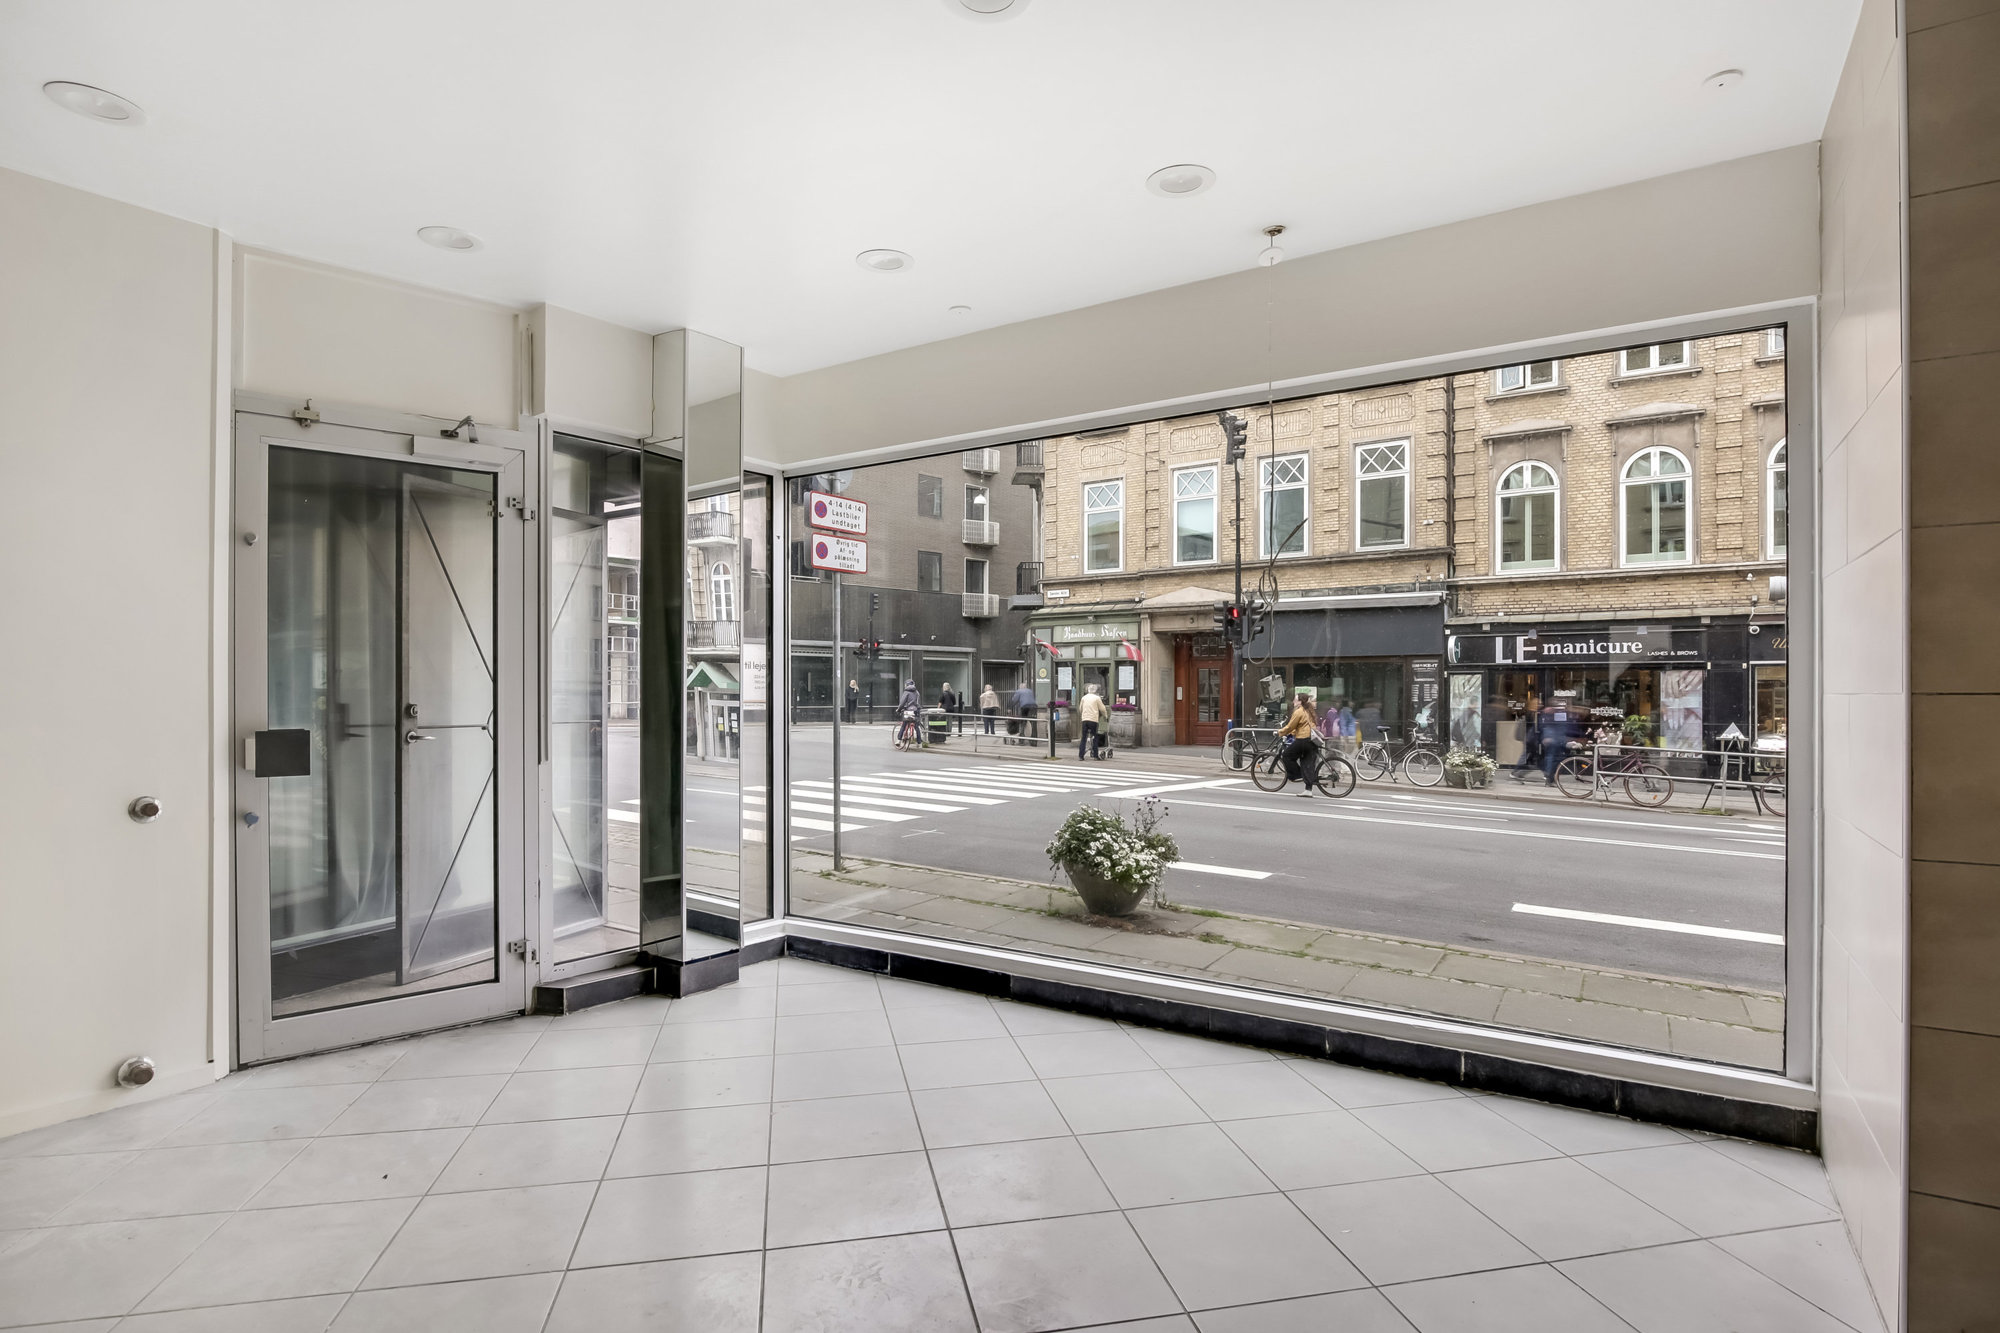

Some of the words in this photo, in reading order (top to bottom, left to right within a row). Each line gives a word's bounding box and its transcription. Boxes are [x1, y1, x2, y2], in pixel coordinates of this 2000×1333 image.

[832, 510, 860, 520] Lastbiler
[832, 519, 860, 529] undtaget
[1495, 636, 1537, 664] LE
[1542, 639, 1643, 656] manicure
[753, 661, 766, 671] leje
